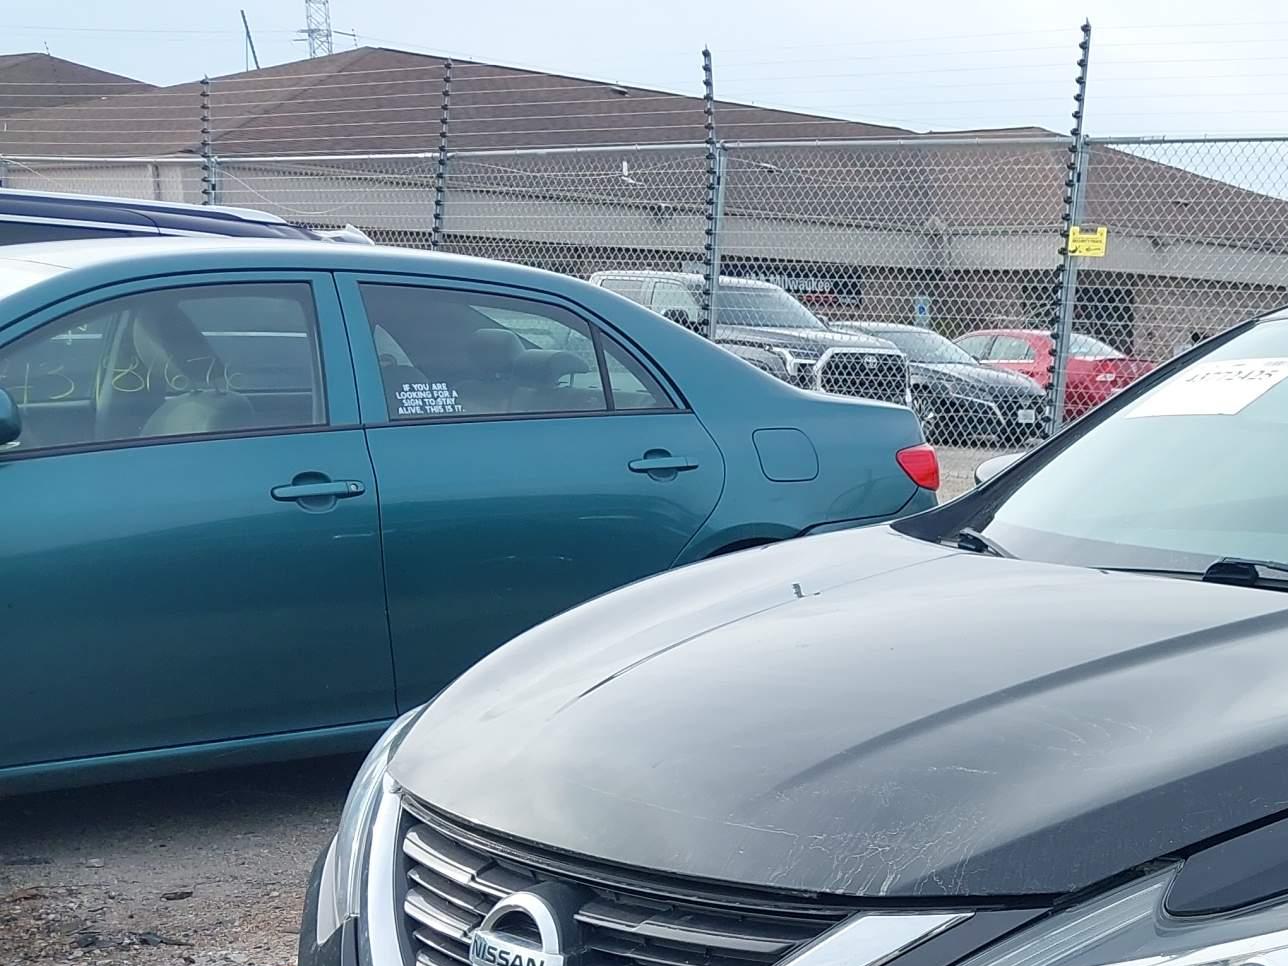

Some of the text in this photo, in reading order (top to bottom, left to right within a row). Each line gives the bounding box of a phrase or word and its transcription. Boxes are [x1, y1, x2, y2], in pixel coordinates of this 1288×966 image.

[411, 383, 429, 391] YOU
[431, 382, 447, 390] ARE
[395, 390, 459, 399] LOOKING FOR A
[402, 398, 423, 406] SIGN
[436, 397, 455, 405] STAY
[425, 405, 444, 413] THIS
[454, 404, 466, 412] IT.
